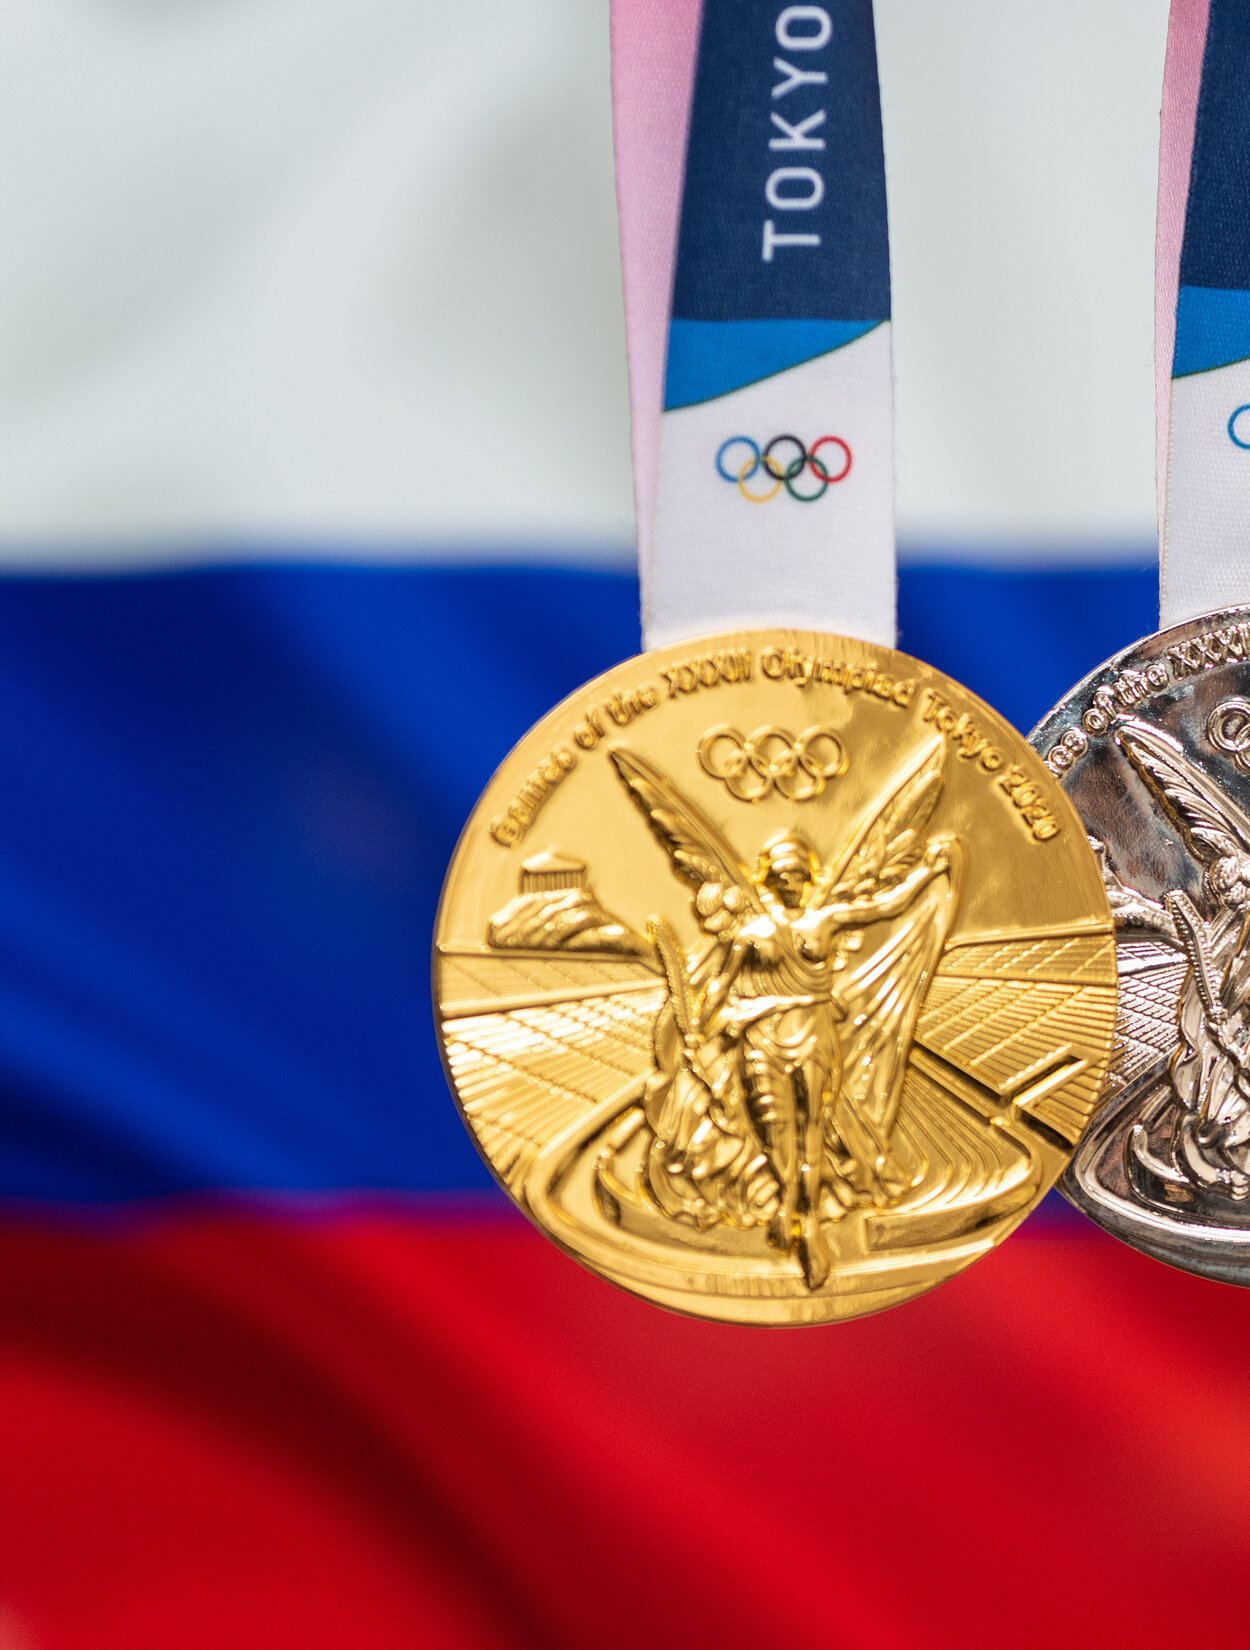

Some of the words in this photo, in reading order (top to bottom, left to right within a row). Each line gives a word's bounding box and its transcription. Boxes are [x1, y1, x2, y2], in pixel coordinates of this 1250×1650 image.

[762, 5, 832, 262] TOKYO
[488, 745, 577, 848] Games
[573, 707, 606, 750] of
[603, 685, 660, 726] the
[659, 647, 753, 698] XXXII
[760, 646, 916, 708] Olympiad
[922, 689, 1002, 771] Tokyo
[999, 763, 1060, 842] 2020
[1082, 685, 1117, 736] of
[1113, 669, 1169, 708] the
